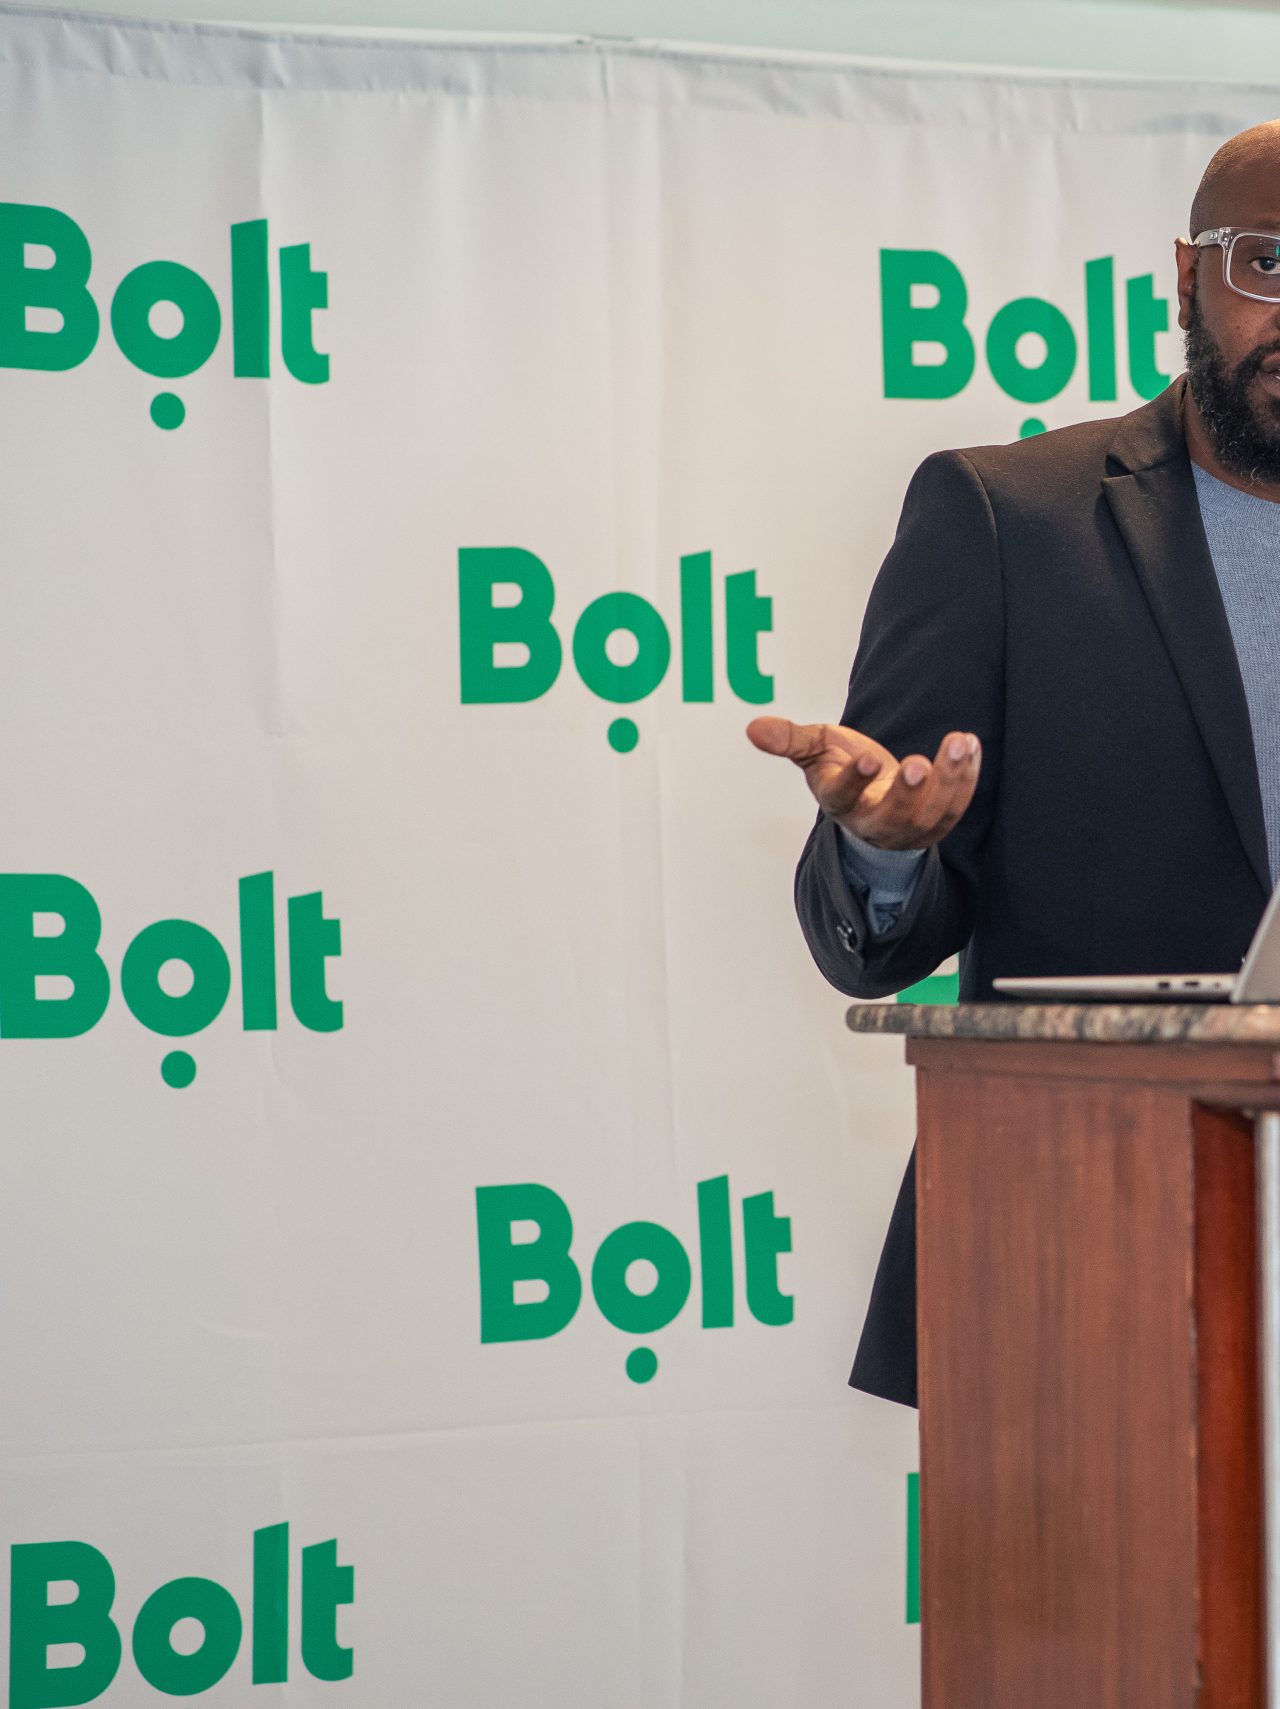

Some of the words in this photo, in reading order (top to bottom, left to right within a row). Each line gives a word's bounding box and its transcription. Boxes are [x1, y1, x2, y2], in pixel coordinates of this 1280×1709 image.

[0, 202, 331, 430] Bolt
[879, 248, 1171, 439] Bolt
[458, 547, 774, 753] Bolt
[0, 871, 344, 1089] Bolt
[475, 1175, 794, 1384] Bolt
[8, 1522, 355, 1709] Bolt
